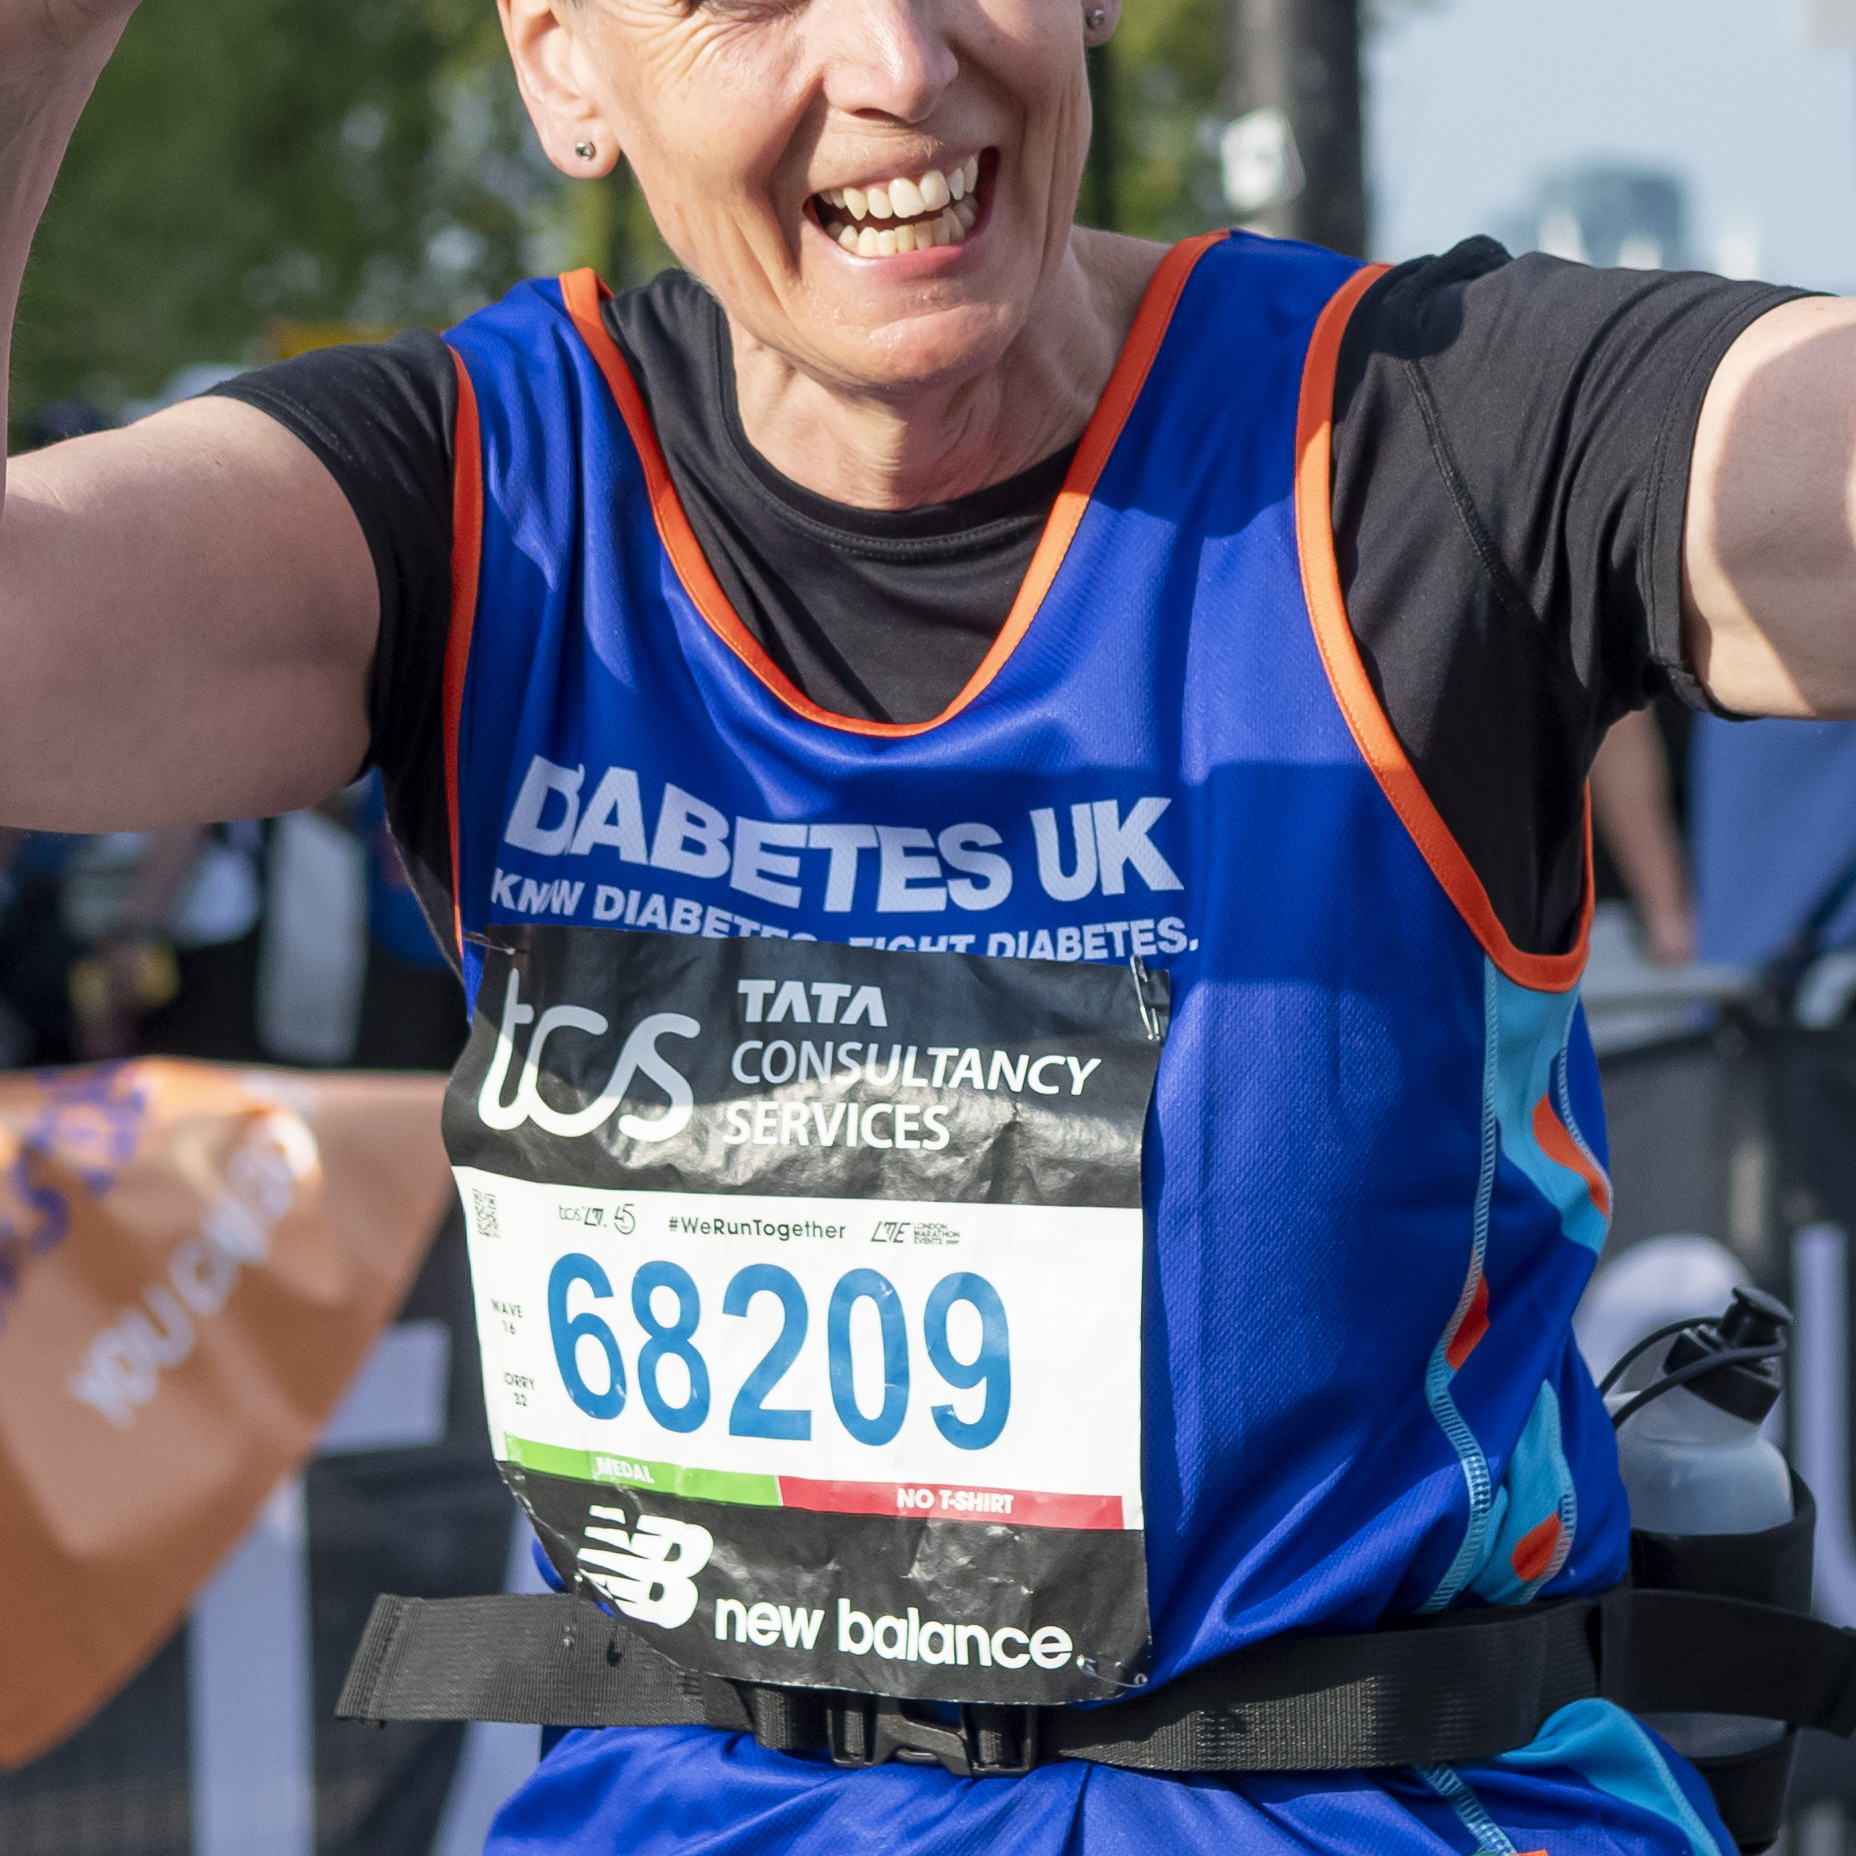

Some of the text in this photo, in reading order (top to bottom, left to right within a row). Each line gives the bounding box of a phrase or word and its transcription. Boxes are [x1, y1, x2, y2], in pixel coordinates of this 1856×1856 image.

[1030, 797, 1185, 902] UK
[737, 979, 887, 1028] TATA
[478, 968, 701, 1142] tcs
[731, 1040, 1101, 1097] CONSULTANCY
[723, 1101, 951, 1150] SERVICES
[669, 1216, 846, 1242] #WeRunTogether
[490, 1298, 523, 1318] WAVE
[546, 1253, 1011, 1451] 68209
[503, 1371, 535, 1391] ORRY
[595, 1456, 655, 1484] MEDAL
[897, 1487, 1014, 1515] NO T-SHIRT
[714, 1597, 1074, 1670] new balance
